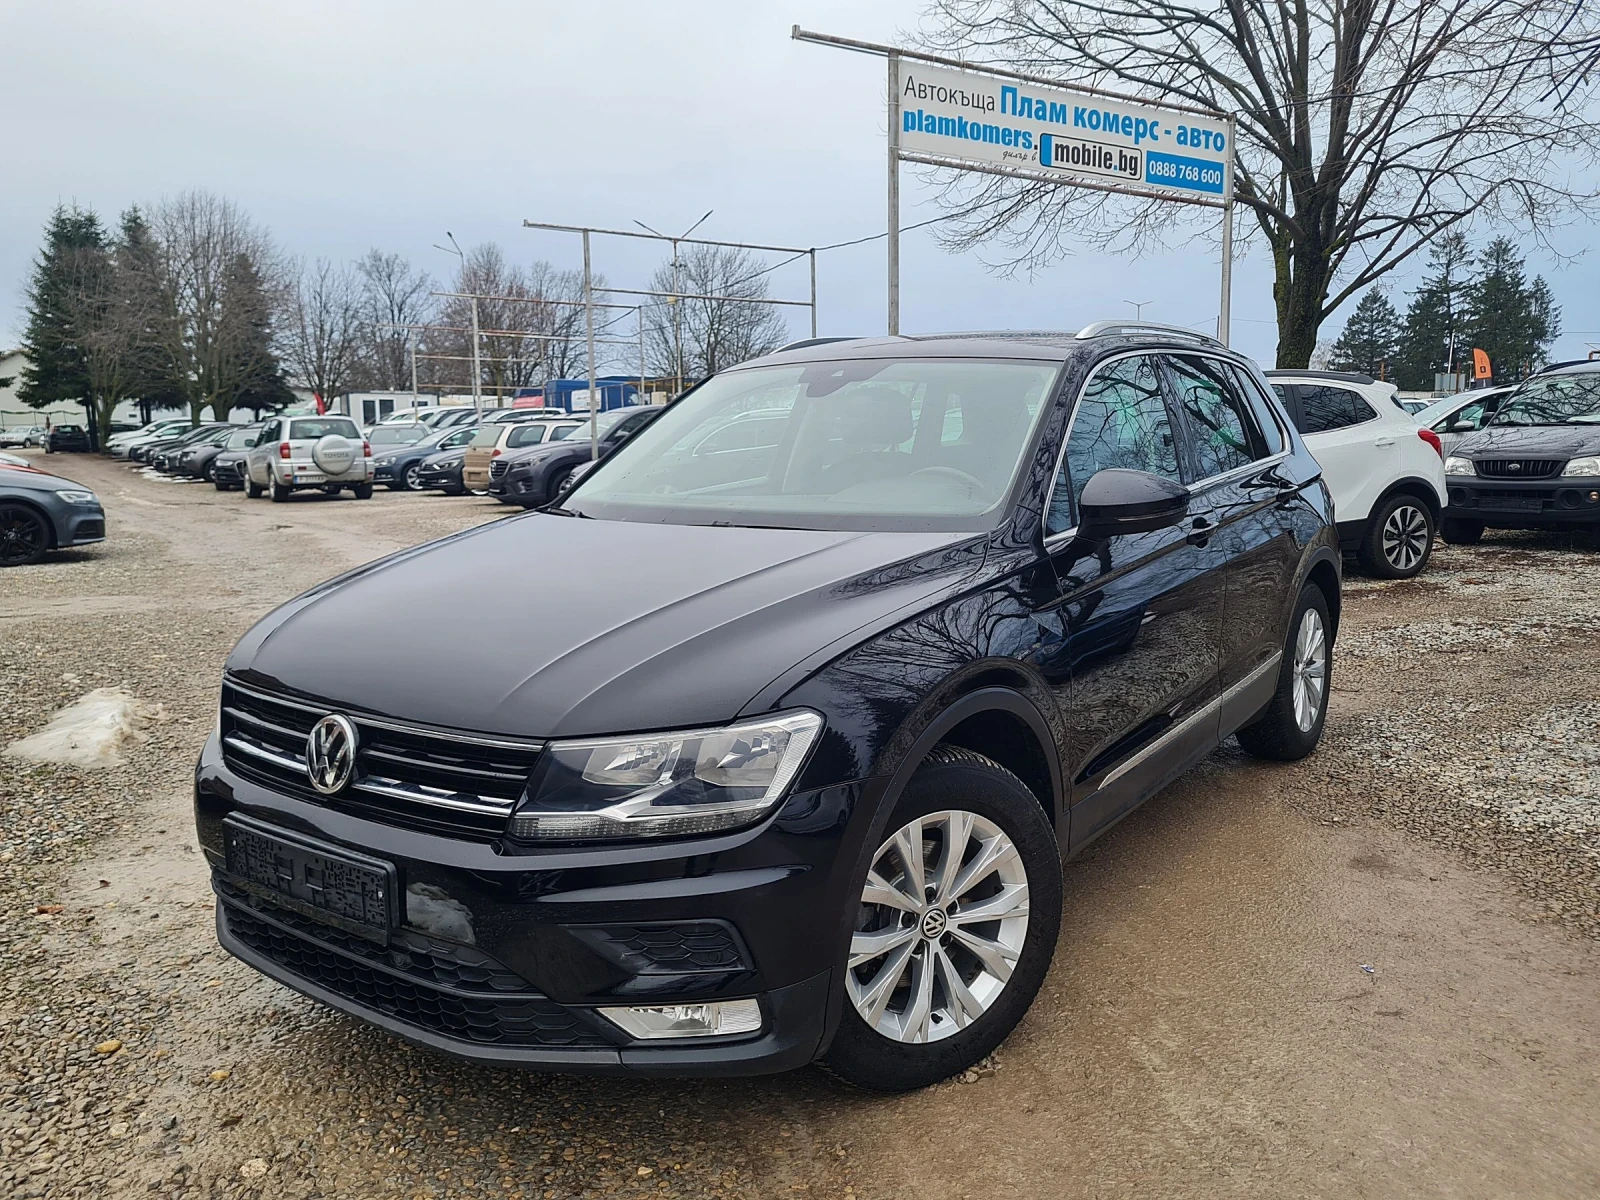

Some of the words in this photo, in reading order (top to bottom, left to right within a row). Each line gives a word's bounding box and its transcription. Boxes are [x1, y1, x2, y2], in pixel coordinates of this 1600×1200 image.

[903, 75, 995, 114] Автокъща
[1001, 85, 1067, 125] Плам
[1073, 106, 1159, 145] комерс
[1176, 125, 1226, 152] авто
[1054, 143, 1138, 176] mobile.bg
[1150, 160, 1176, 179] 0888
[1179, 164, 1199, 182] 768
[1201, 169, 1221, 185] 600
